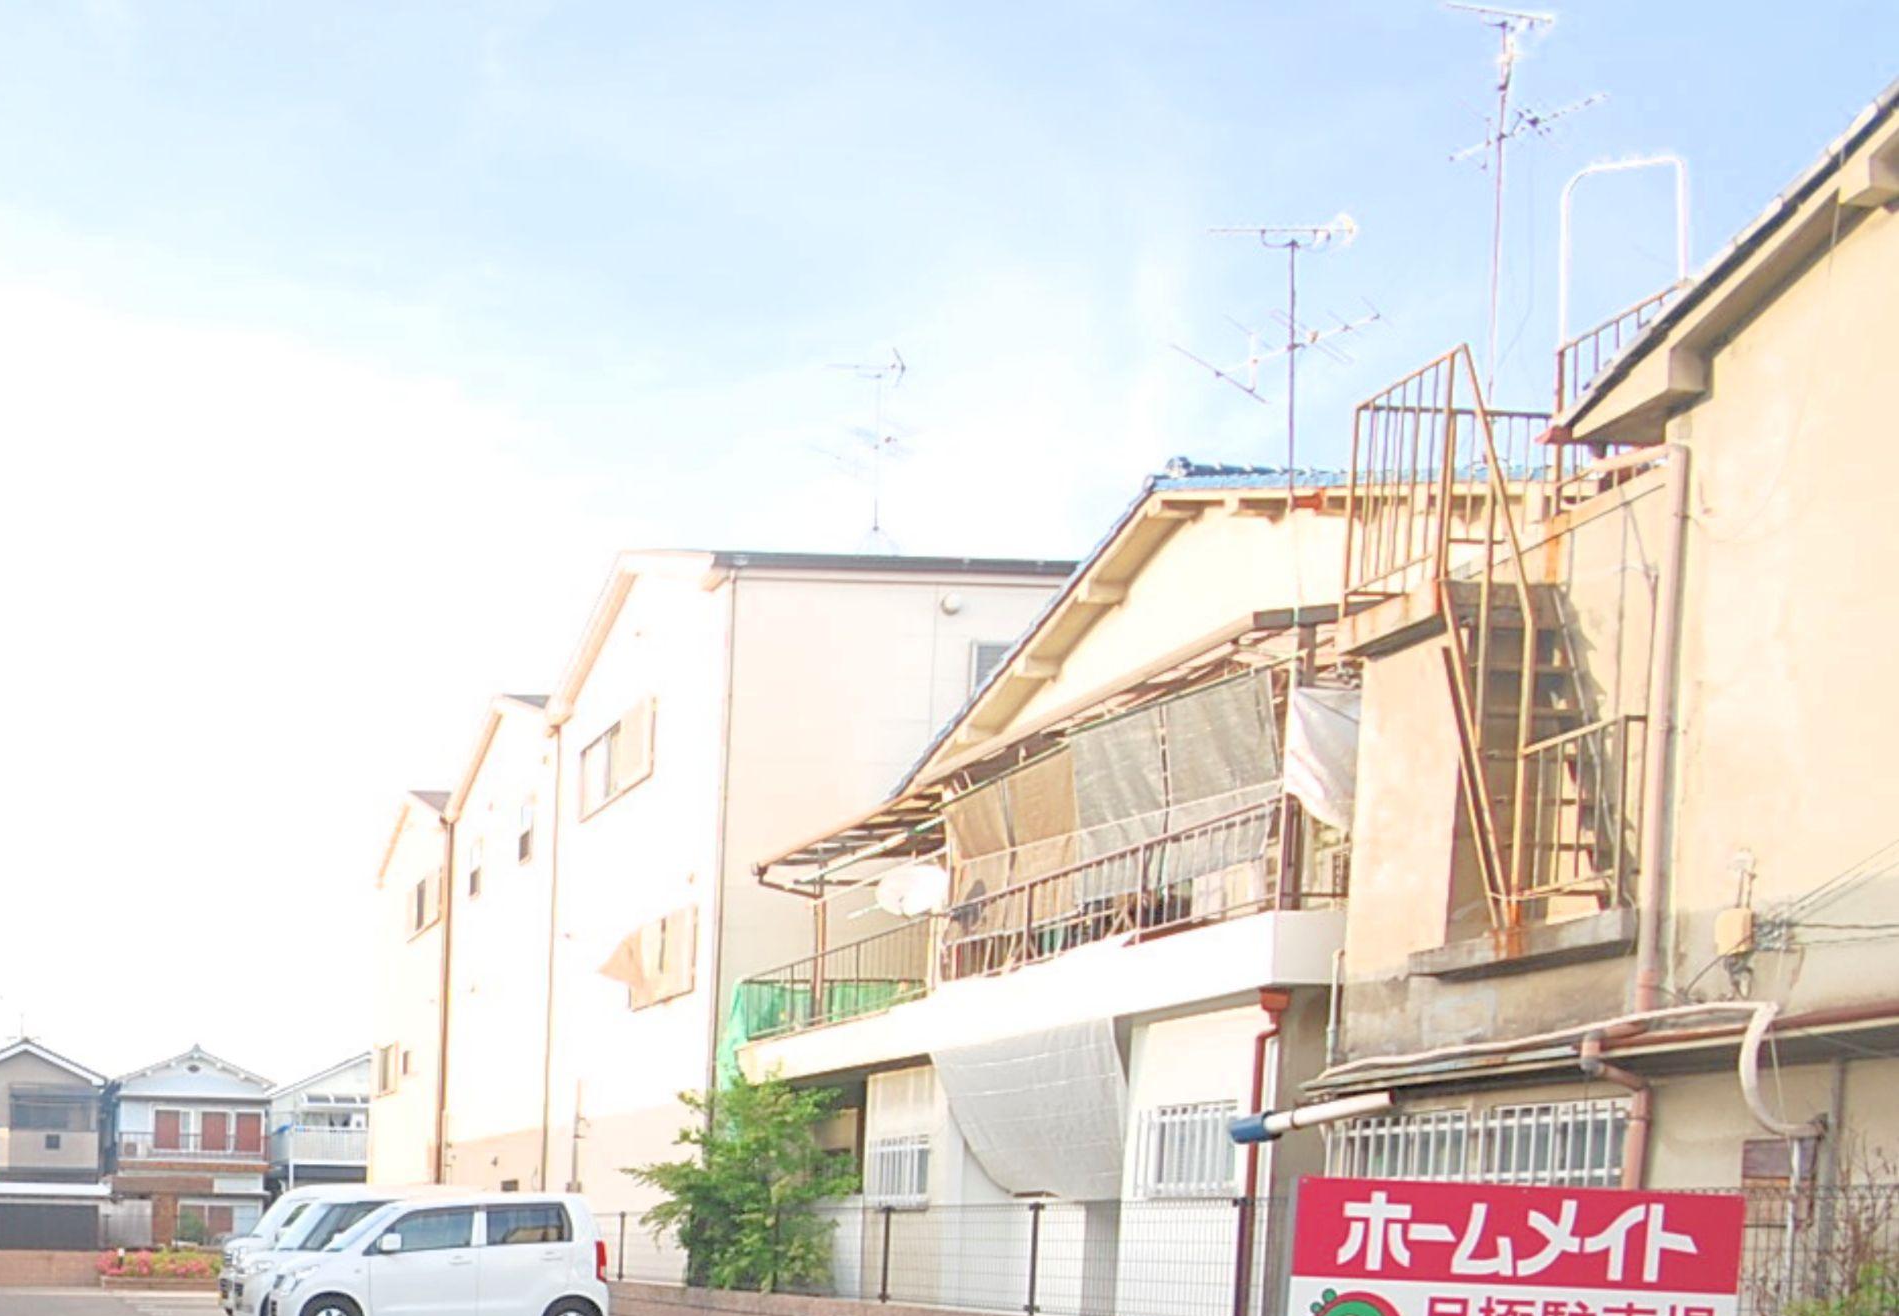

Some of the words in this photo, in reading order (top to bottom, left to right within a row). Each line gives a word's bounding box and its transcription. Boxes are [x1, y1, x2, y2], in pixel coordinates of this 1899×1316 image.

[1336, 1190, 1699, 1283] ホームメイト
